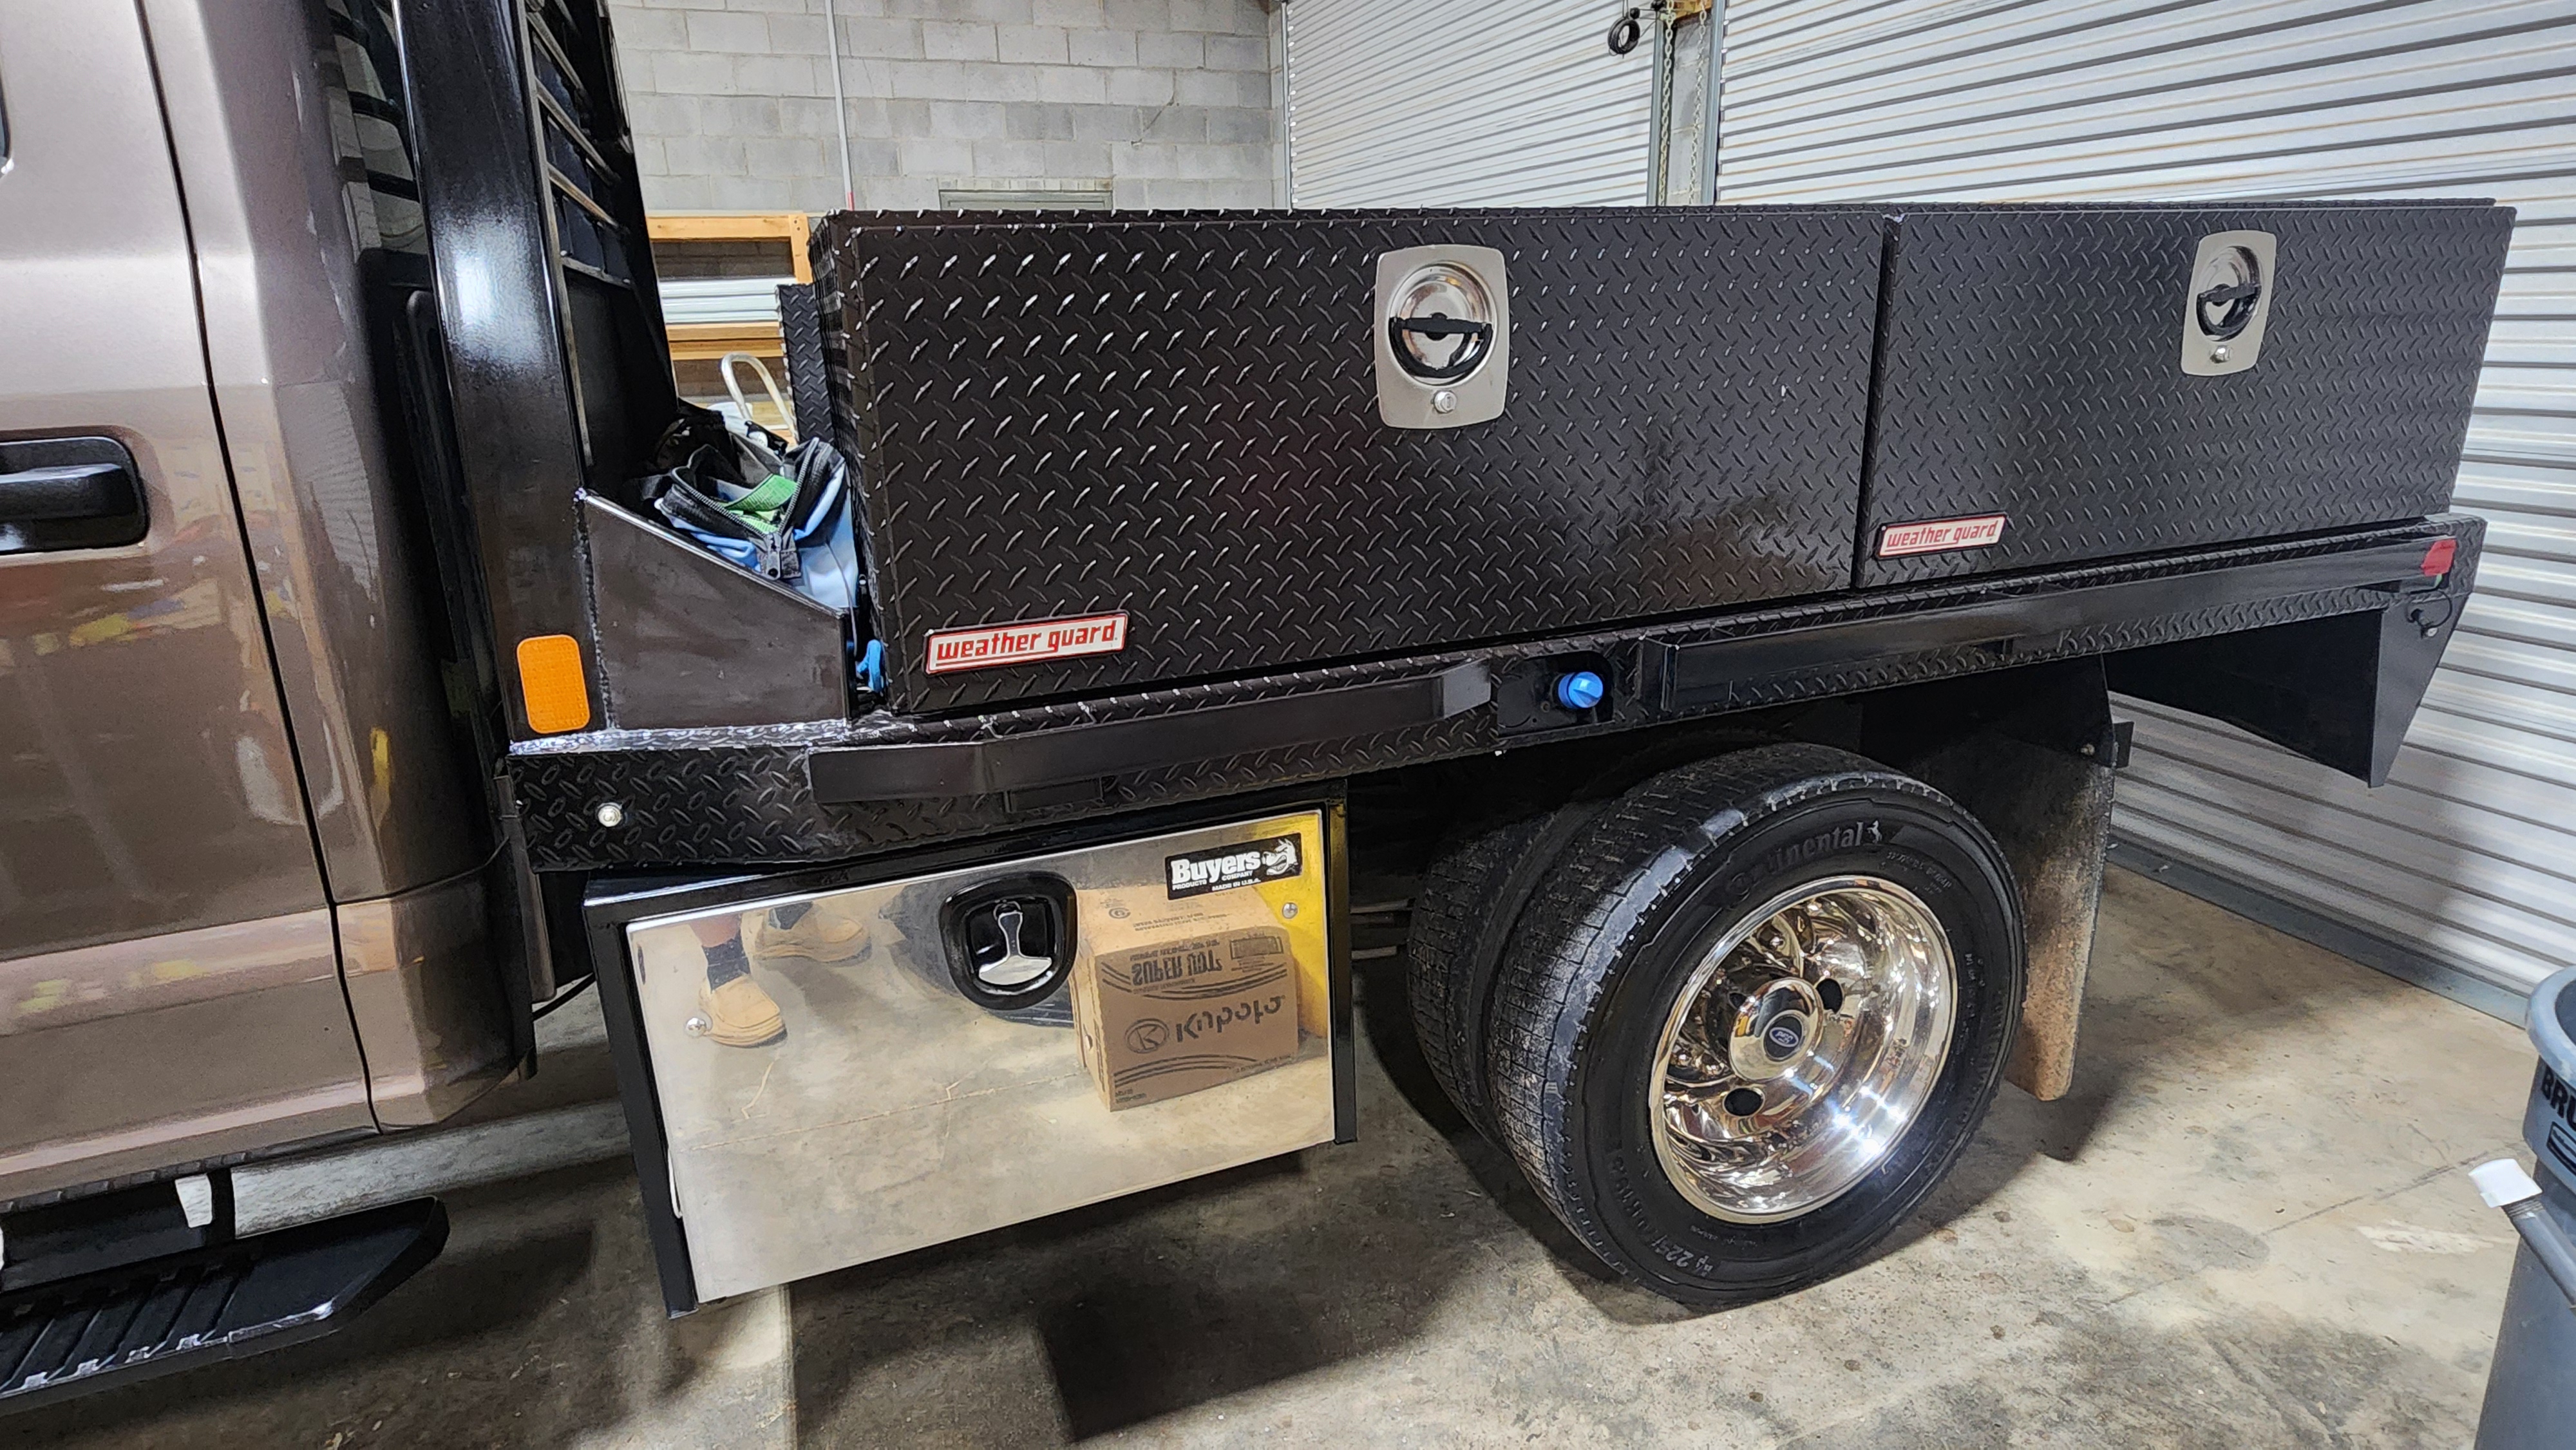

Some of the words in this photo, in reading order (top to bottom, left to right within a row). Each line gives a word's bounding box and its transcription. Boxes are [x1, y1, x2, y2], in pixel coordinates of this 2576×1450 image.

[1887, 526, 1951, 547] weather
[1953, 520, 1999, 543] guard
[936, 631, 1041, 661] weather
[1048, 620, 1117, 653] guard
[1170, 851, 1261, 883] Buyers
[1172, 880, 1208, 891] PRODUCTS
[1221, 870, 1253, 881] COMPANY
[1212, 883, 1232, 891] MADE
